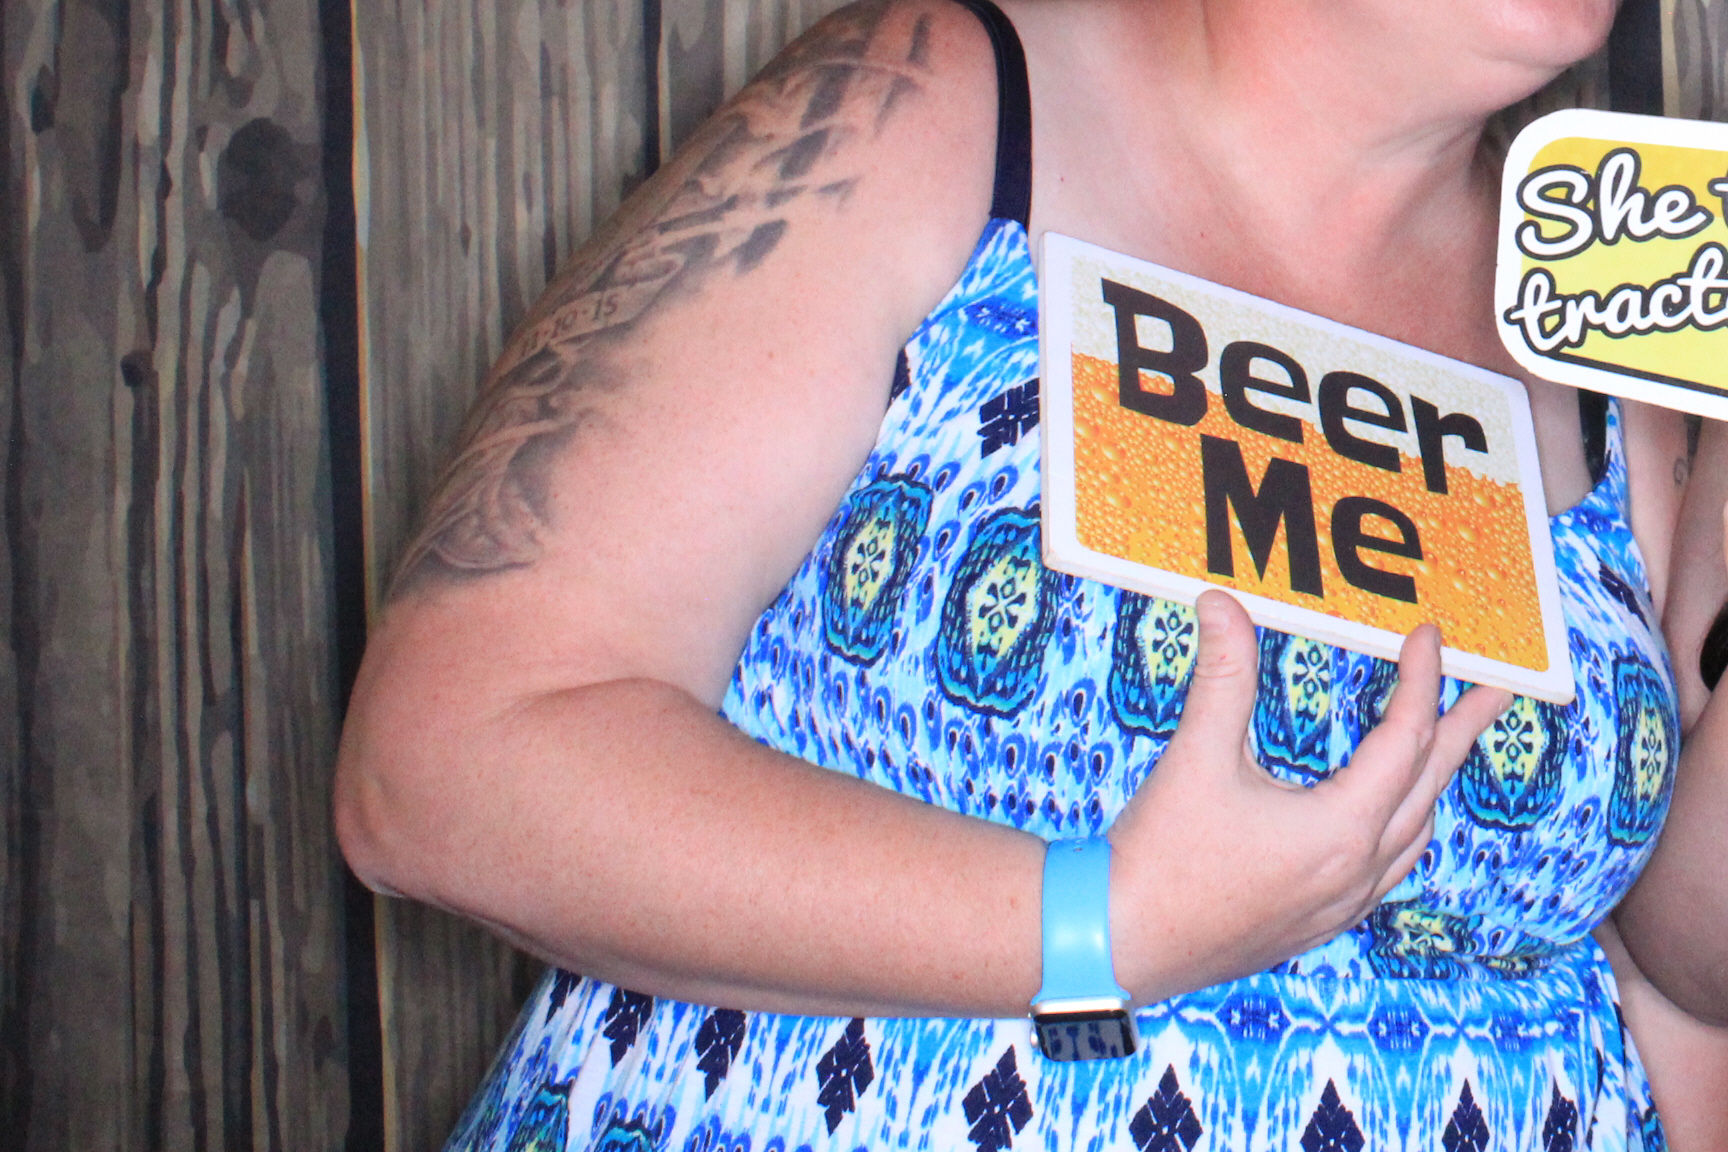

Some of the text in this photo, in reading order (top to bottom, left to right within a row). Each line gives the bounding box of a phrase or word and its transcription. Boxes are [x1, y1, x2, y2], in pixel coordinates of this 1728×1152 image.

[1515, 147, 1714, 260] She
[1101, 277, 1489, 495] Beer
[1200, 433, 1424, 605] Me
